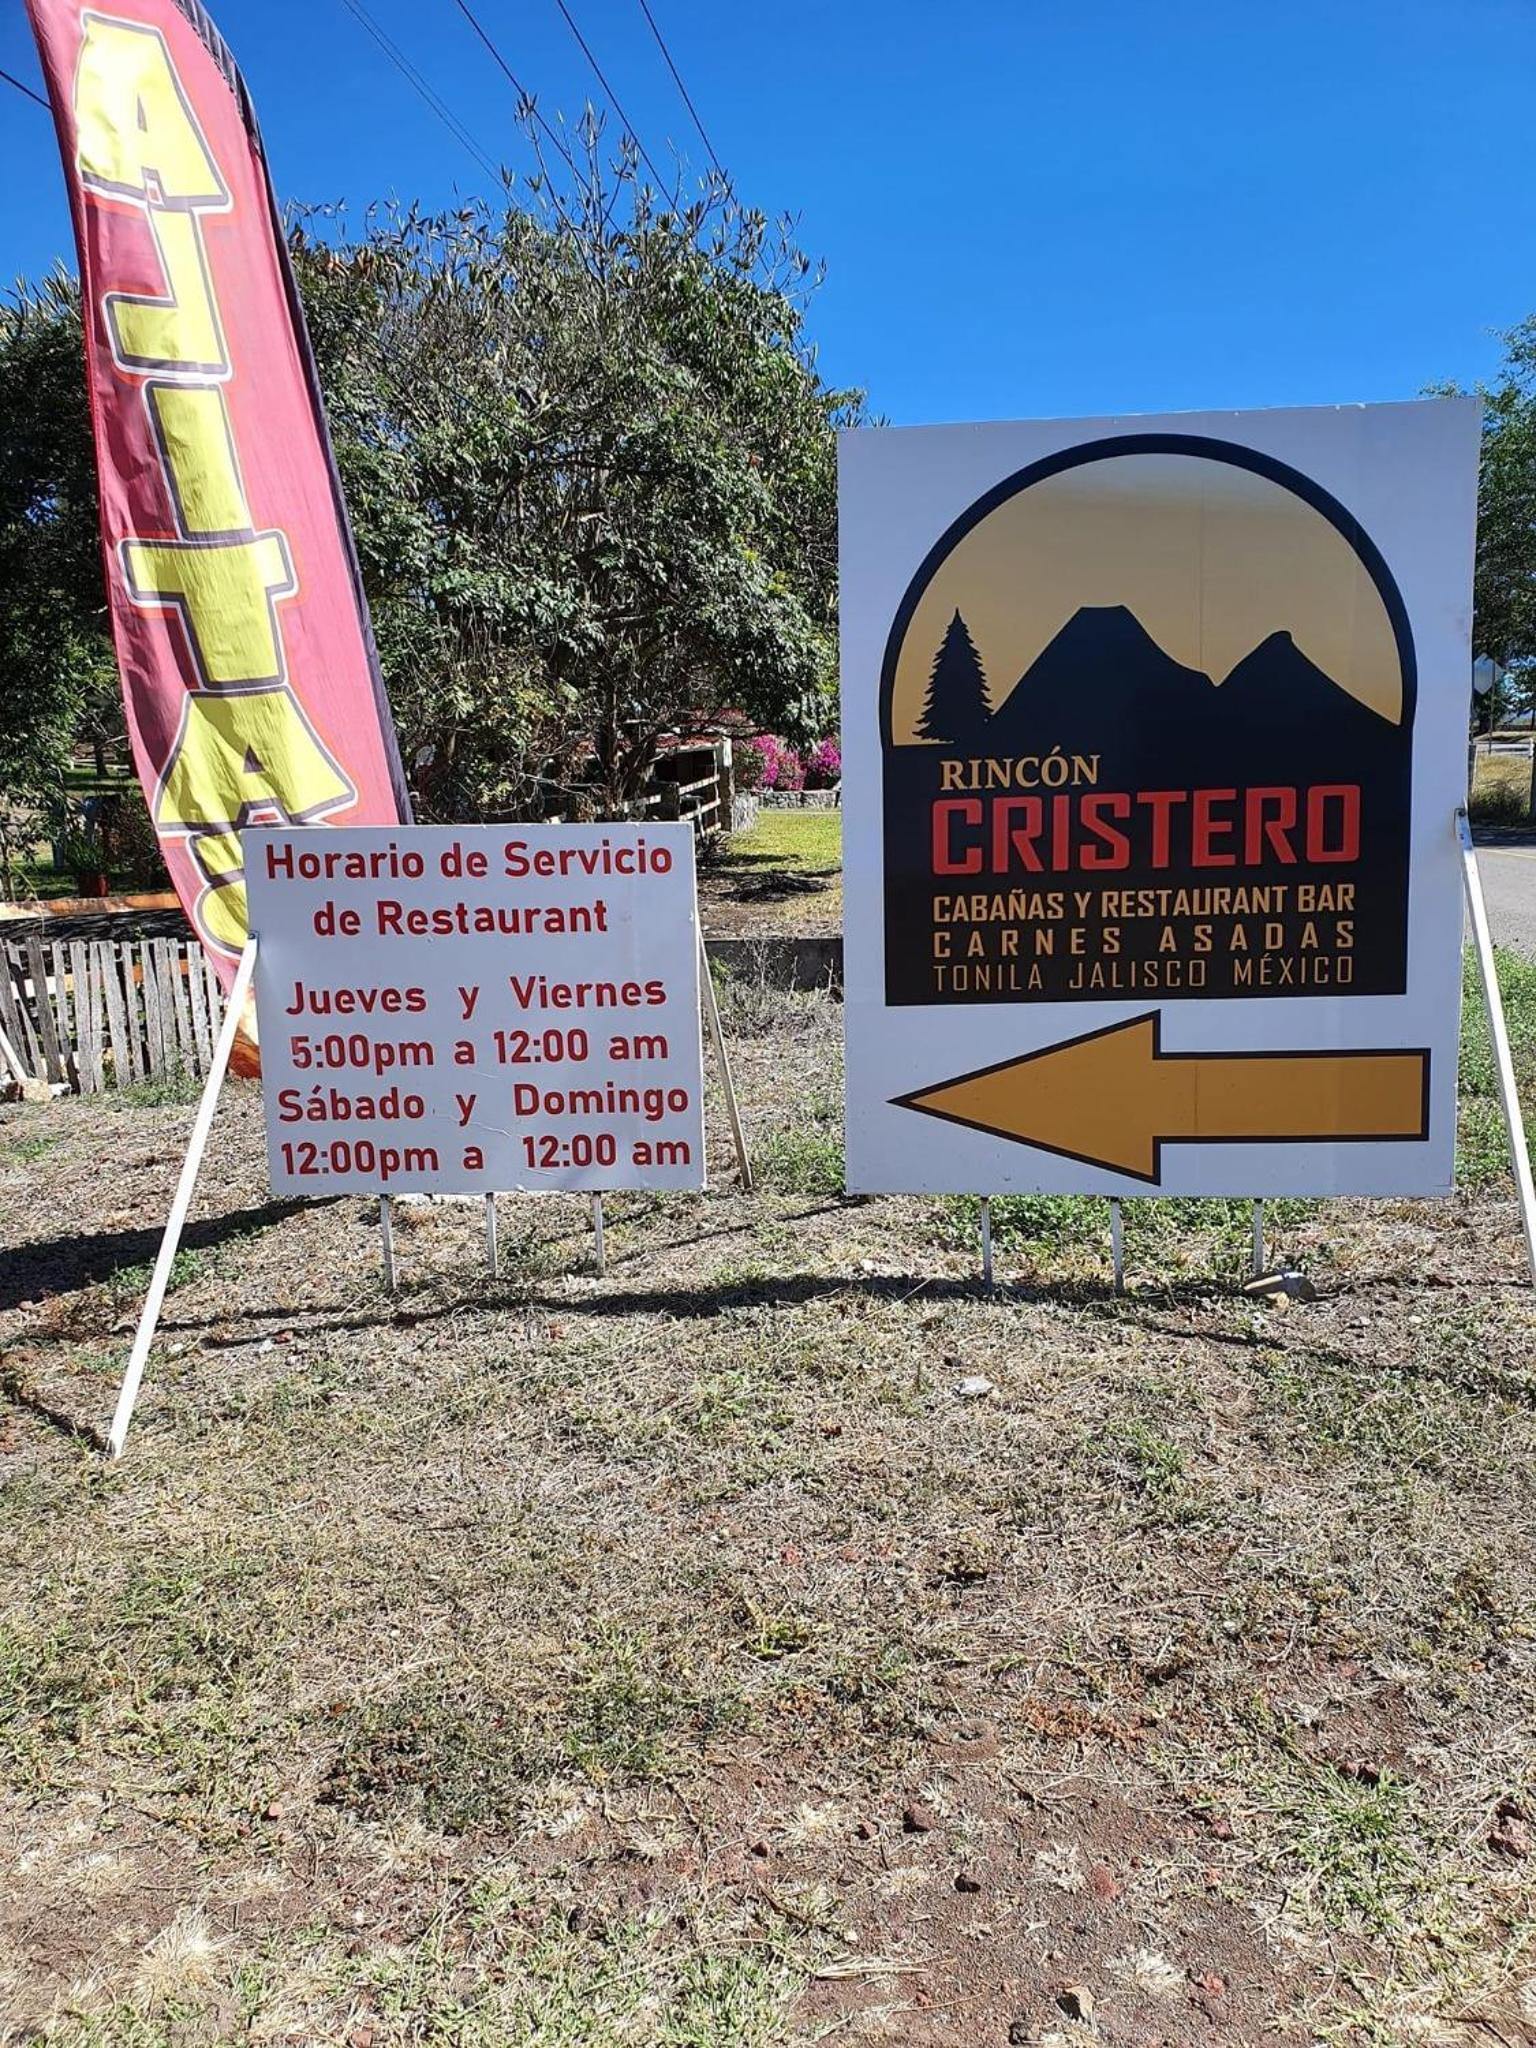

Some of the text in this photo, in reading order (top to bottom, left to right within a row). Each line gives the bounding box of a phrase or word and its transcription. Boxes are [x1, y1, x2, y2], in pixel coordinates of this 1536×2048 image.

[941, 746, 1100, 790] RINCÓN
[933, 786, 1359, 874] CRISTERO
[267, 841, 672, 880] Horario de Servicio
[314, 900, 608, 937] de Restaurant
[934, 884, 1354, 922] CABAÑAS Y RESTAURANT BAR
[934, 921, 1353, 957] CARNES ASADAS
[933, 954, 1354, 990] TONILA JALISCO MÉXICO
[287, 977, 666, 1019] Jueves y Viernes
[291, 1028, 668, 1074] 5:00pm a 12:00 am
[278, 1084, 688, 1125] Sábado y Domingo
[282, 1135, 690, 1180] 12:00pm a 12:00 am
